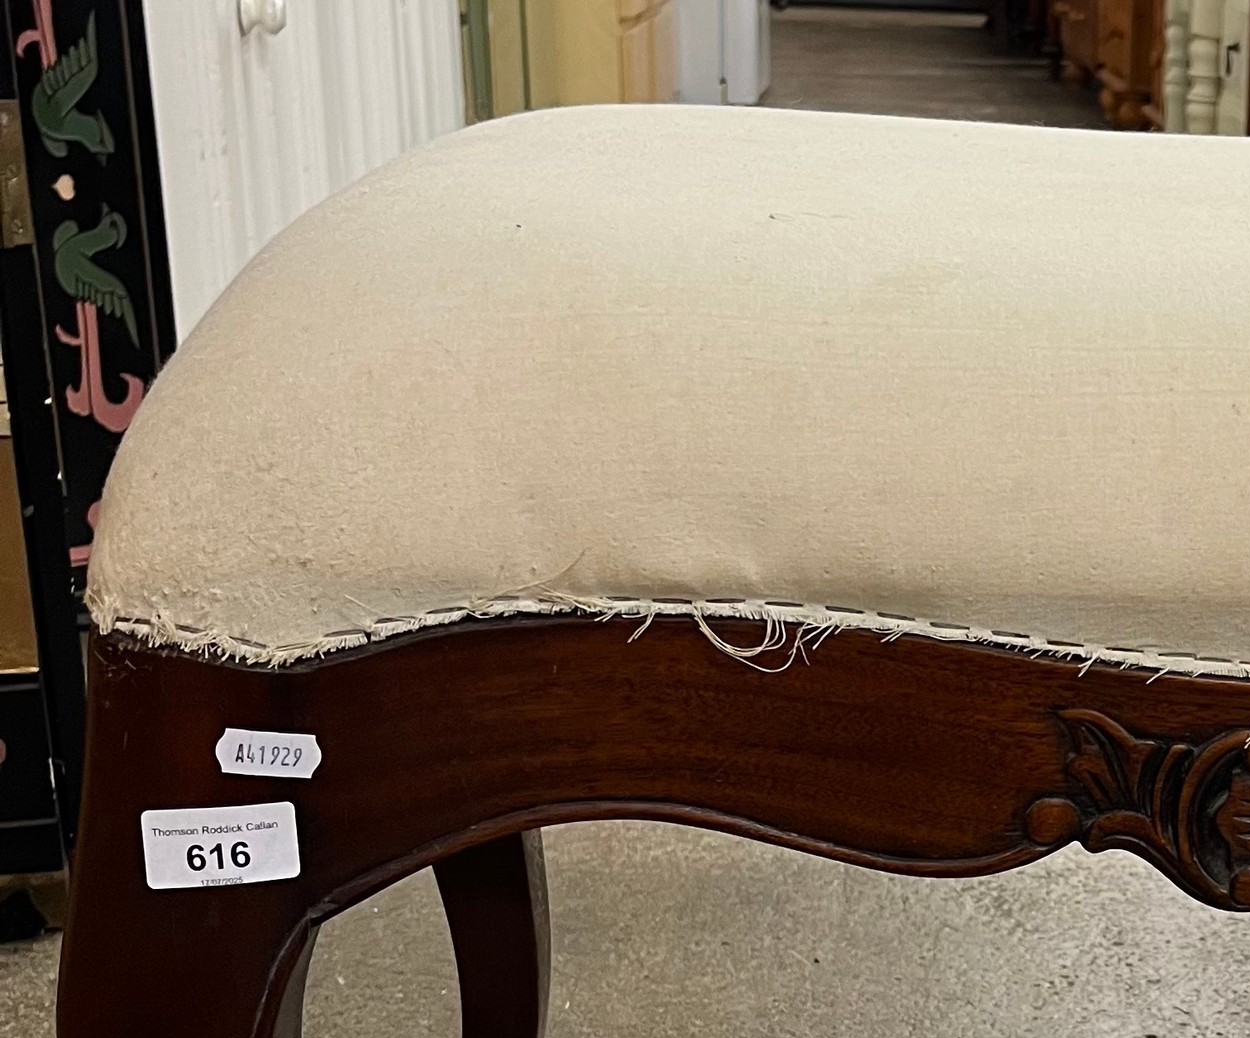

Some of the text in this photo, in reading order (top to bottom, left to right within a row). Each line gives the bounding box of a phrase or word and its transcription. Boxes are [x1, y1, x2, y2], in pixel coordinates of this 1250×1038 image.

[235, 743, 303, 767] A41929
[152, 820, 279, 837] Thomson Roddick Callan
[186, 841, 251, 871] 616
